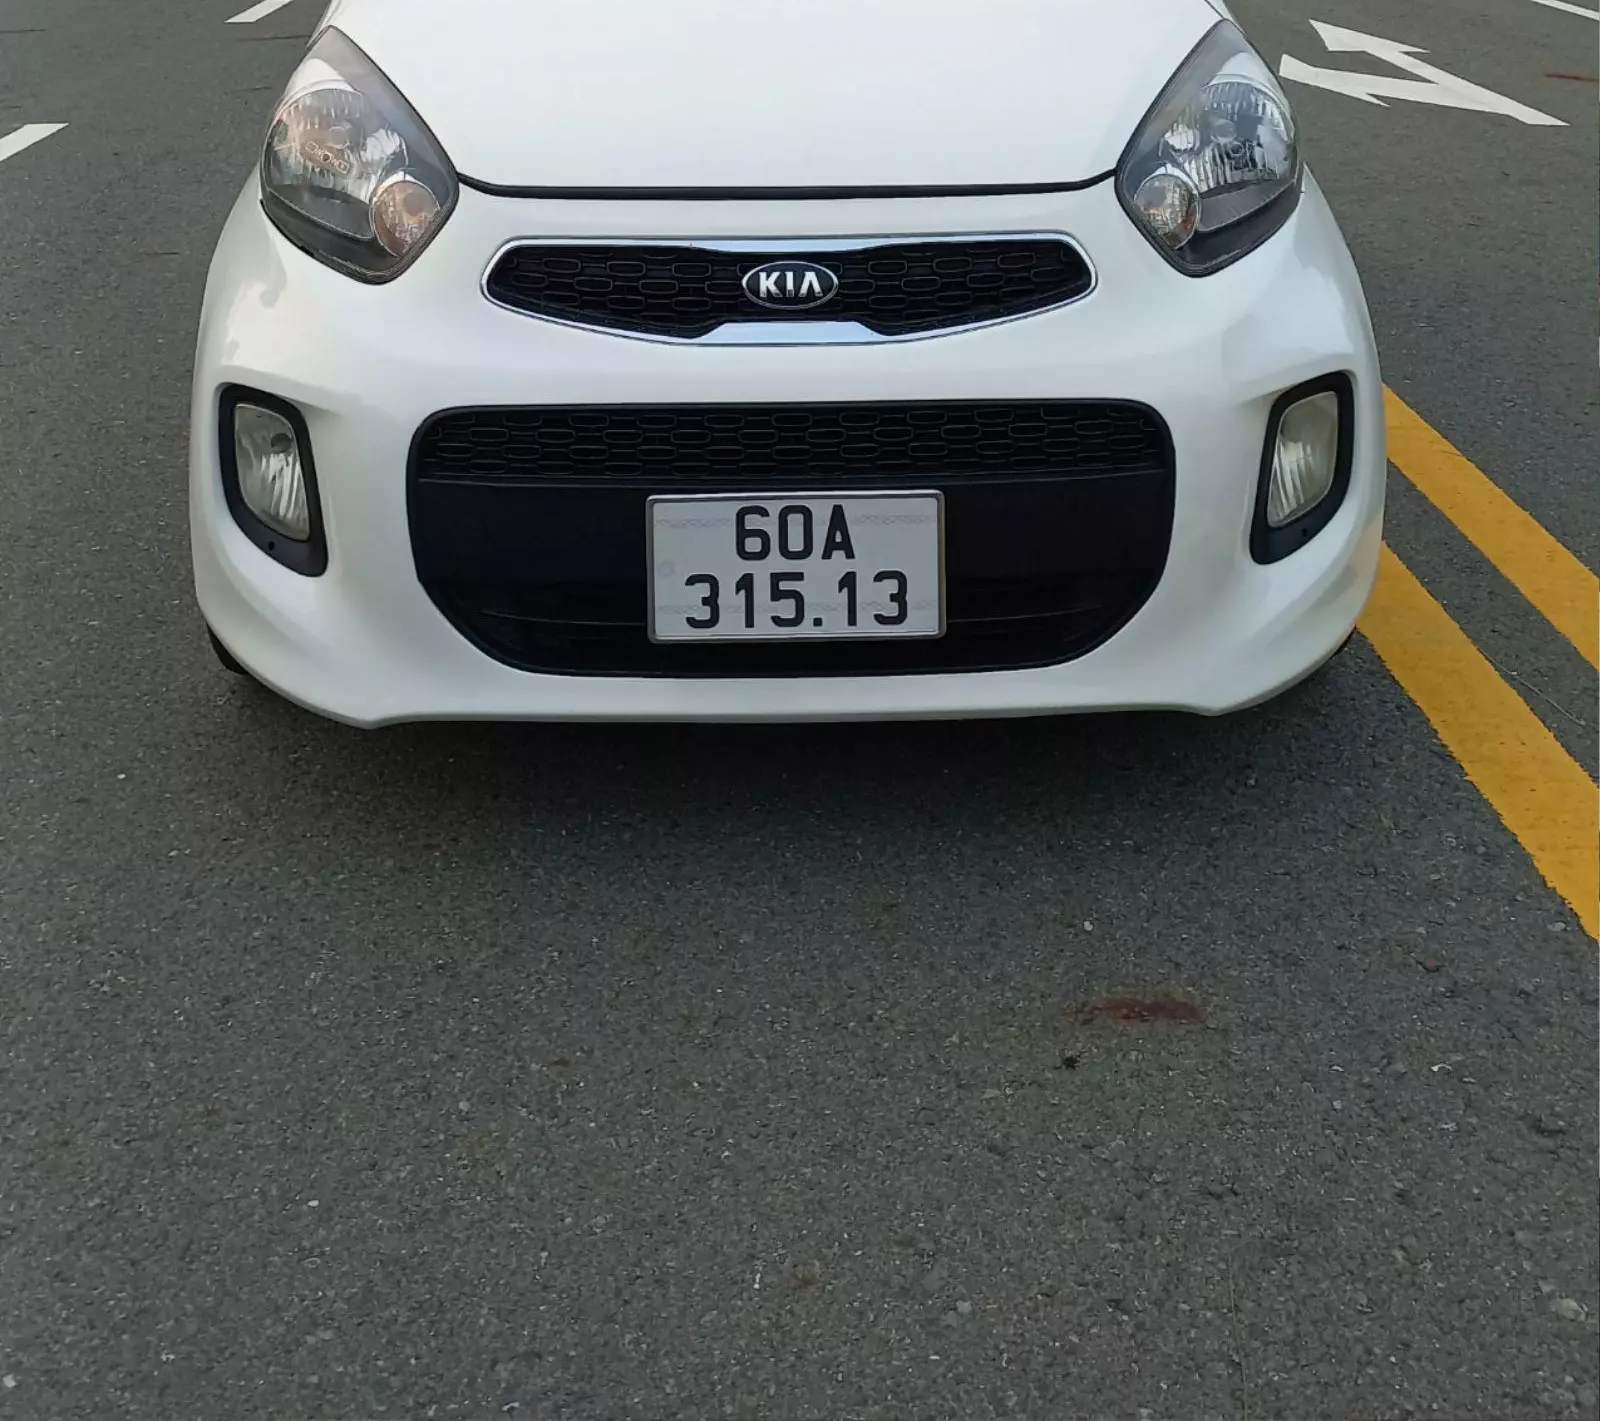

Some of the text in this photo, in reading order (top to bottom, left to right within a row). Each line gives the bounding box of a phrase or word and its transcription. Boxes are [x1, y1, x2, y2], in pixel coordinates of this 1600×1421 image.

[758, 271, 824, 298] KIA
[735, 504, 855, 561] 60A
[684, 570, 908, 629] 315.13
